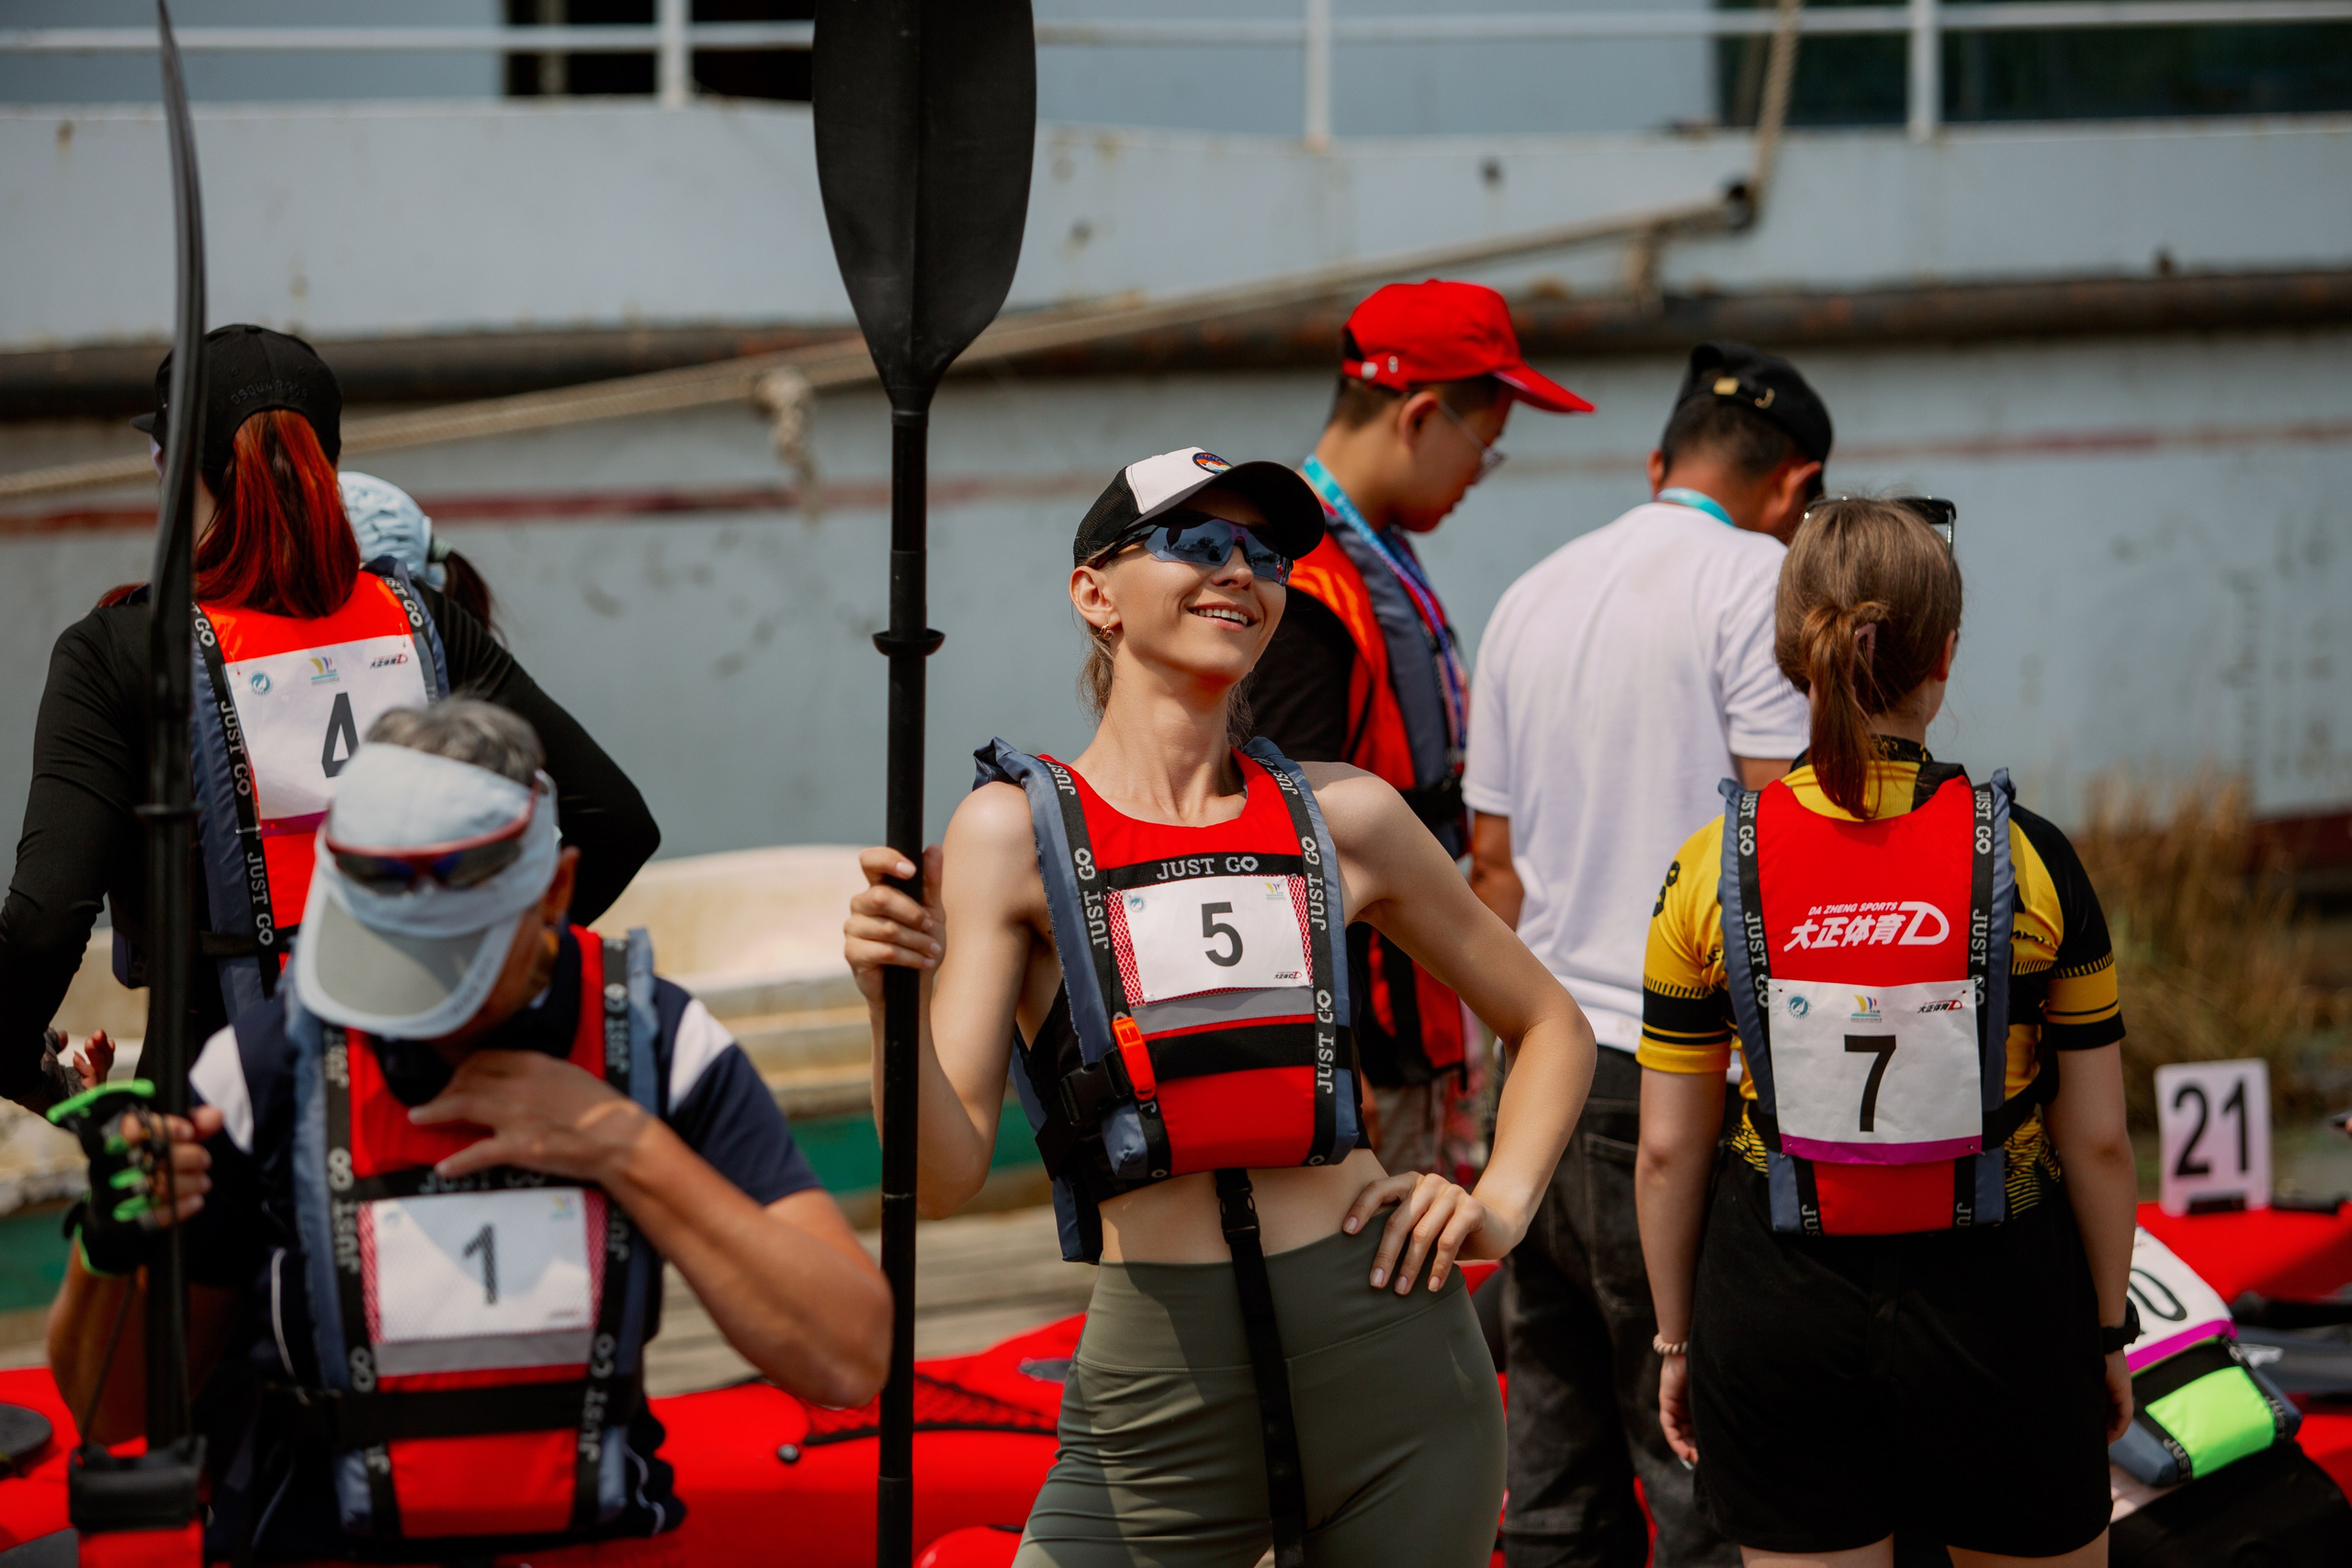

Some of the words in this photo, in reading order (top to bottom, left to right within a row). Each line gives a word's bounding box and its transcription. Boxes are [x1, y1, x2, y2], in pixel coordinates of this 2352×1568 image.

[195, 617, 216, 648] GO
[403, 600, 424, 627] GO
[220, 700, 245, 755] JUST
[233, 762, 251, 796] GO
[1046, 761, 1077, 795] JUST
[1268, 767, 1298, 795] JUST
[1739, 791, 1758, 818] JUST
[1975, 790, 1991, 820] JUST
[1301, 836, 1320, 865] GO
[1738, 825, 1755, 856] GO
[1975, 826, 1991, 855] GO
[247, 852, 268, 906] JUST
[1074, 847, 1095, 881] GO
[1156, 858, 1215, 880] JUST
[1226, 856, 1259, 872] GO
[1083, 891, 1110, 950] JUST
[1307, 873, 1327, 931] JUST
[1808, 906, 1822, 916] DA
[1825, 903, 1858, 915] ZHENG
[1859, 902, 1898, 912] SPORTS
[256, 912, 274, 946] GO
[1201, 901, 1243, 967] 5
[1745, 911, 1767, 966] JUST
[1783, 913, 1906, 953] 大正体育
[1971, 908, 1987, 965] JUST
[604, 983, 628, 1012] GO
[1317, 989, 1334, 1024] GO
[1754, 974, 1770, 1009] GO
[605, 1016, 630, 1074] JUST
[1317, 1032, 1334, 1094] JUST
[1843, 1034, 1896, 1133] 7
[2174, 1078, 2247, 1177] 21
[328, 1146, 355, 1191] GO
[333, 1200, 361, 1275] JUST
[463, 1223, 497, 1304] 1
[349, 1346, 376, 1393] GO
[592, 1333, 616, 1378] GO
[578, 1386, 609, 1462] JUST
[2163, 1438, 2193, 1479] JUST
